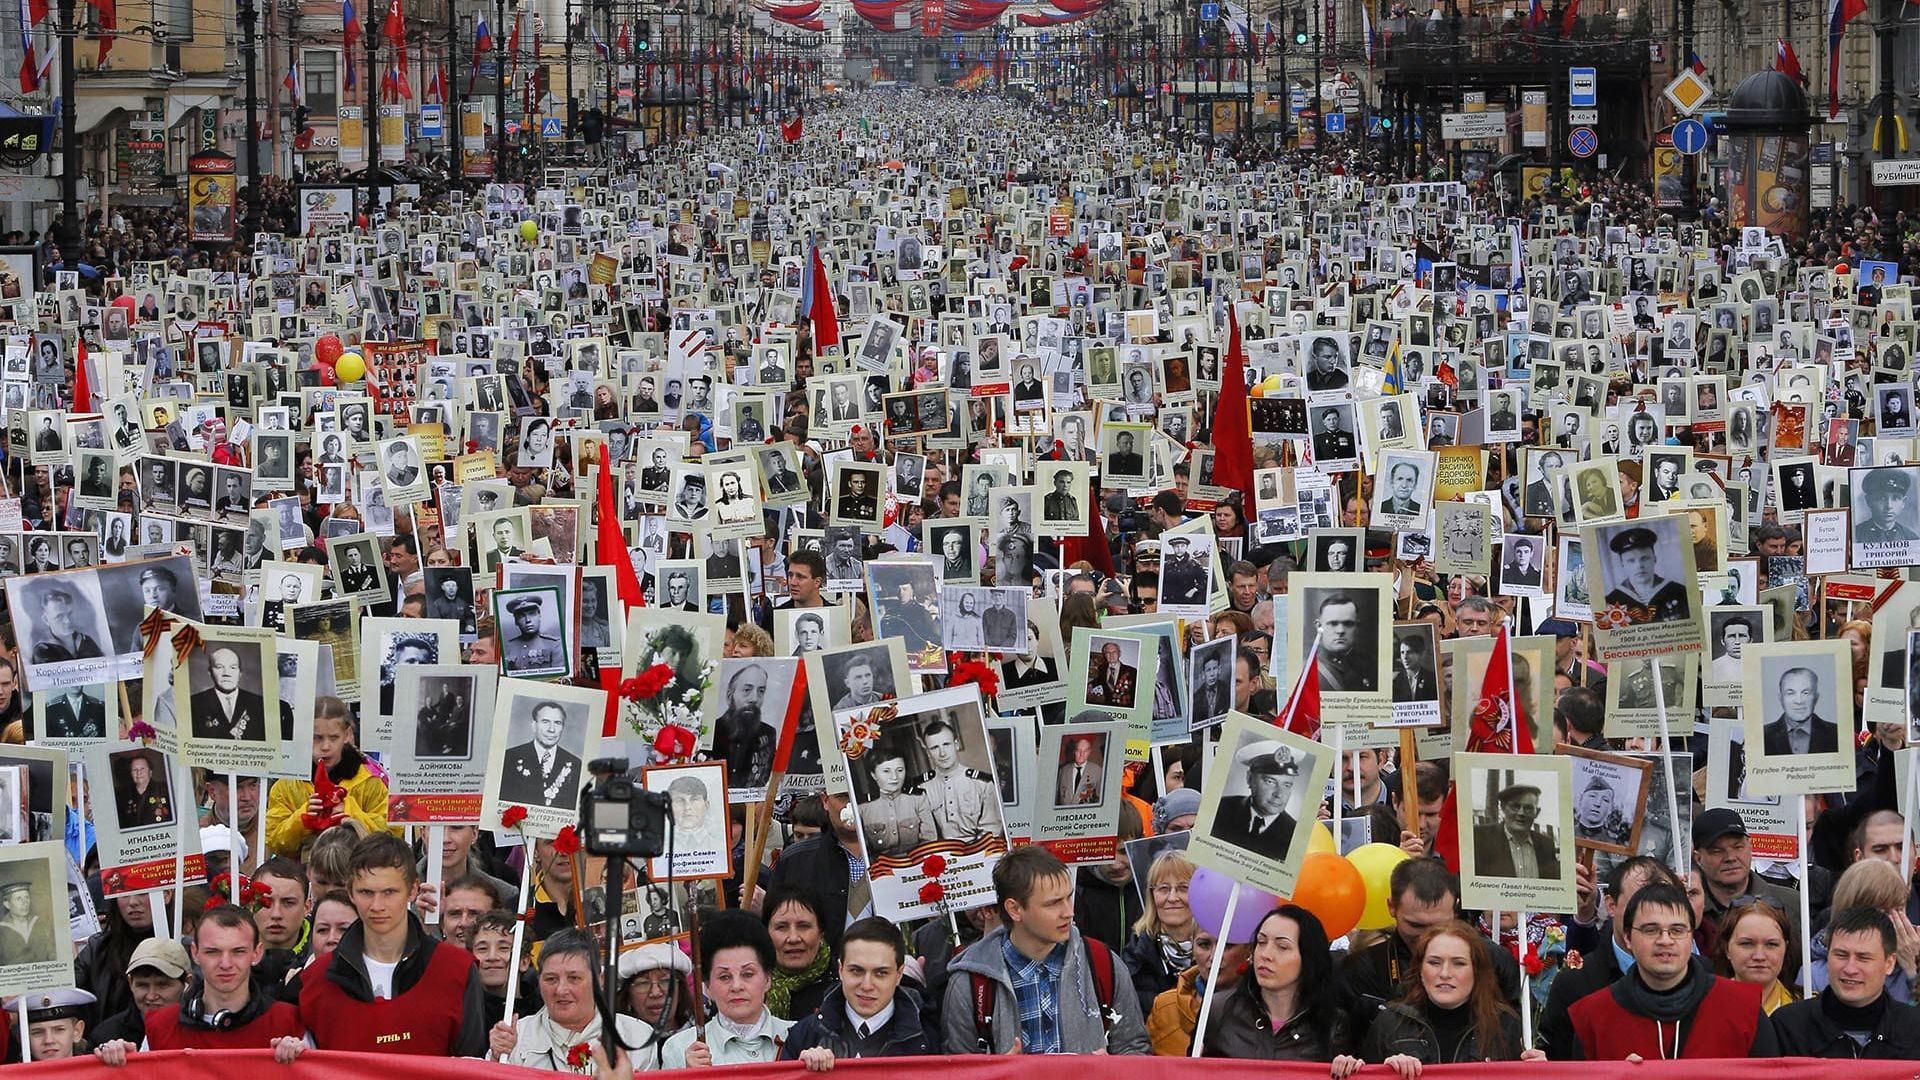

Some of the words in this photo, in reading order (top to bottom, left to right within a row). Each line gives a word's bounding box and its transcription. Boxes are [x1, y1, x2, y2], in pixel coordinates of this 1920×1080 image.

[1439, 478, 1475, 486] РЯДОВОЙ
[1863, 540, 1910, 550] КУЛАНОВ
[1865, 550, 1908, 559] ГРИГОРИЙ
[1859, 558, 1914, 568] СТЕПАНОВИЧ
[1603, 645, 1674, 660] Бессмертный
[1676, 642, 1703, 653] полк
[36, 664, 76, 677] Коробков
[77, 661, 108, 673] Сергей
[53, 675, 95, 686] Иванович
[1107, 711, 1128, 720] ОЗОВ
[1396, 710, 1439, 718] ГРИГОРЬЕВИЧ
[232, 744, 276, 753] Дмитриевич
[186, 750, 217, 759] Сержант
[418, 763, 463, 771] ДОЙНИКОВЫ
[1752, 766, 1780, 776] Груздев
[1808, 764, 1850, 773] Николаевич
[1786, 773, 1817, 781] Рядовой
[416, 798, 466, 807] Бессмертный
[530, 806, 576, 818] Константин
[1734, 808, 1770, 816] ШАКИРОВ
[1055, 813, 1097, 822] ПИВОВАРОВ
[1744, 816, 1786, 825] Шакирович
[1040, 823, 1072, 834] Григорий
[1073, 821, 1110, 831] Сергеевич
[127, 832, 171, 845] ИГНАТЬЕВА
[120, 848, 141, 857] Вера
[142, 841, 178, 853] Павловн
[1055, 841, 1097, 850] Бессмертный
[1752, 842, 1793, 852] т-Петербурга
[161, 850, 177, 859] служ
[665, 851, 691, 859] Ддник
[1063, 846, 1114, 855] Санкт-Петербурга
[131, 862, 176, 875] Бессмертны
[672, 860, 714, 868] рофимович
[1469, 881, 1501, 889] Абрамов
[1499, 891, 1537, 899] ефрейтор
[31, 963, 68, 972] Петрович
